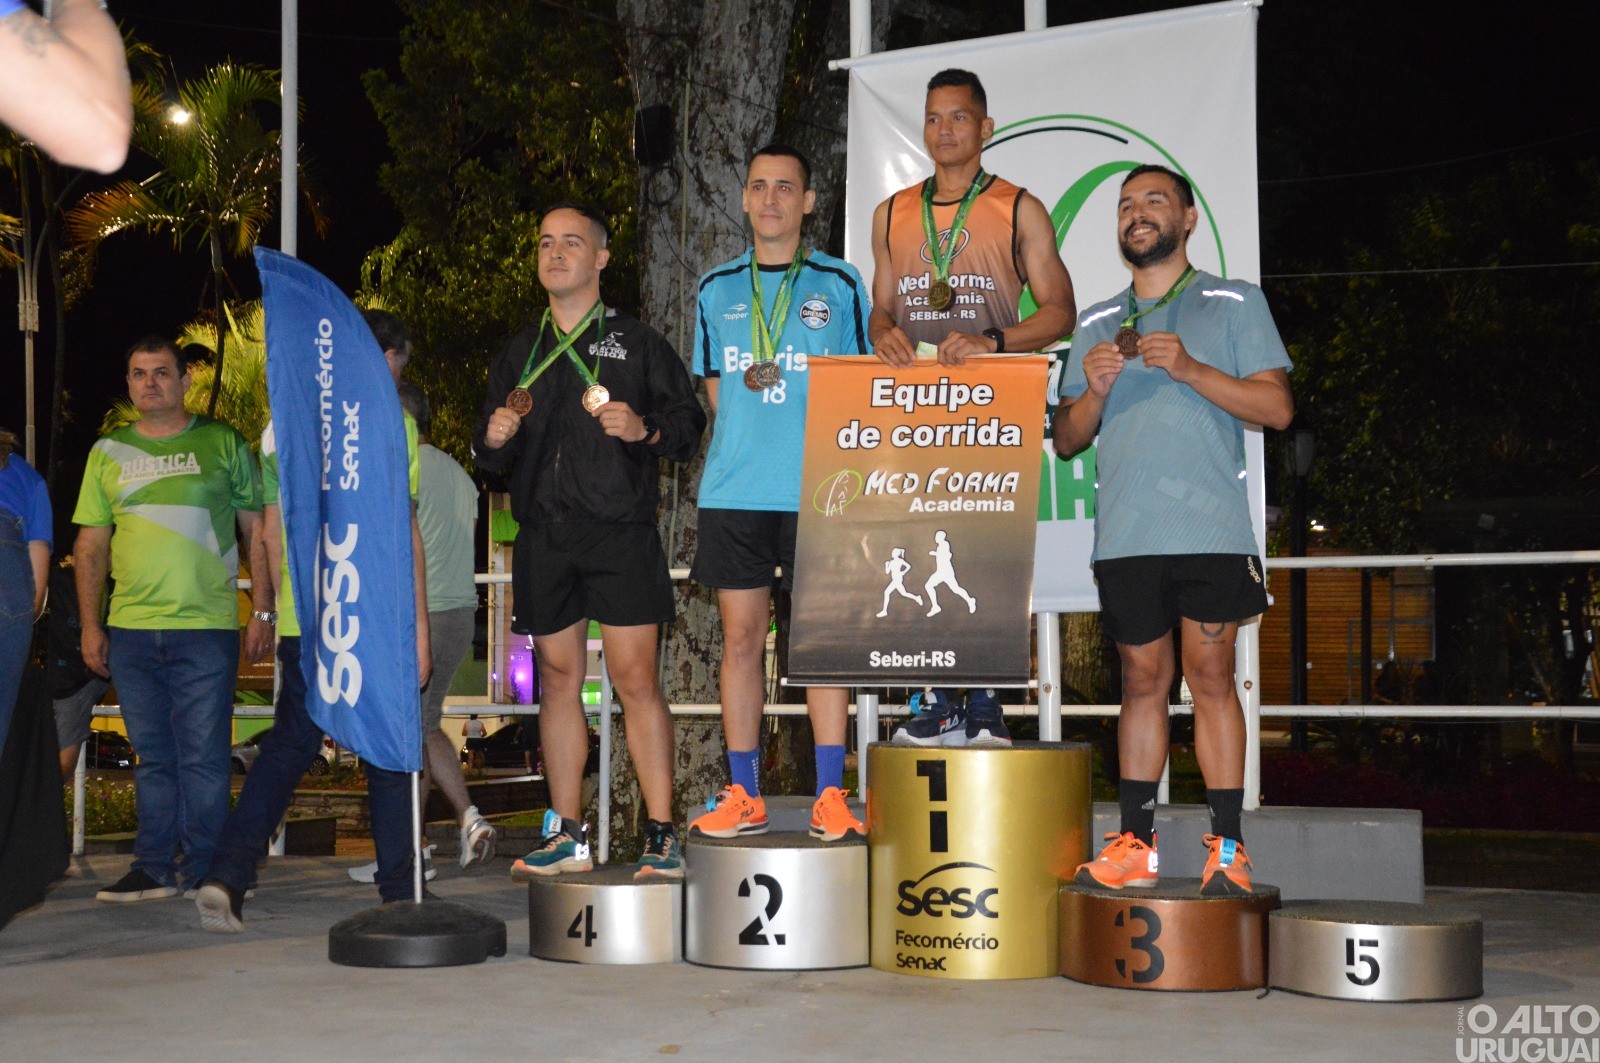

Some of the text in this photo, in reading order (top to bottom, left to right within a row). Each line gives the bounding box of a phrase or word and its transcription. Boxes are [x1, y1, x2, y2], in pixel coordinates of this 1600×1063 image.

[946, 274, 995, 290] orma
[904, 291, 985, 307] Acamia
[723, 312, 749, 320] Topper
[960, 309, 976, 319] RS
[314, 317, 333, 491] Fecomércio
[762, 379, 787, 404] 18
[871, 377, 994, 413] Equipe
[339, 401, 360, 491] Senac
[836, 420, 881, 449] de
[891, 417, 1022, 447] corrida
[924, 467, 1020, 494] FORMA
[908, 497, 1015, 513] Academia
[869, 650, 956, 668] Seberi-RS
[939, 713, 959, 733] FILA
[916, 759, 948, 852] 1
[738, 873, 786, 946] 2
[567, 905, 597, 947] 4
[896, 929, 999, 951] Fecomércio
[1114, 905, 1165, 983] 3
[896, 952, 947, 971] Senac
[1345, 938, 1380, 986] 5
